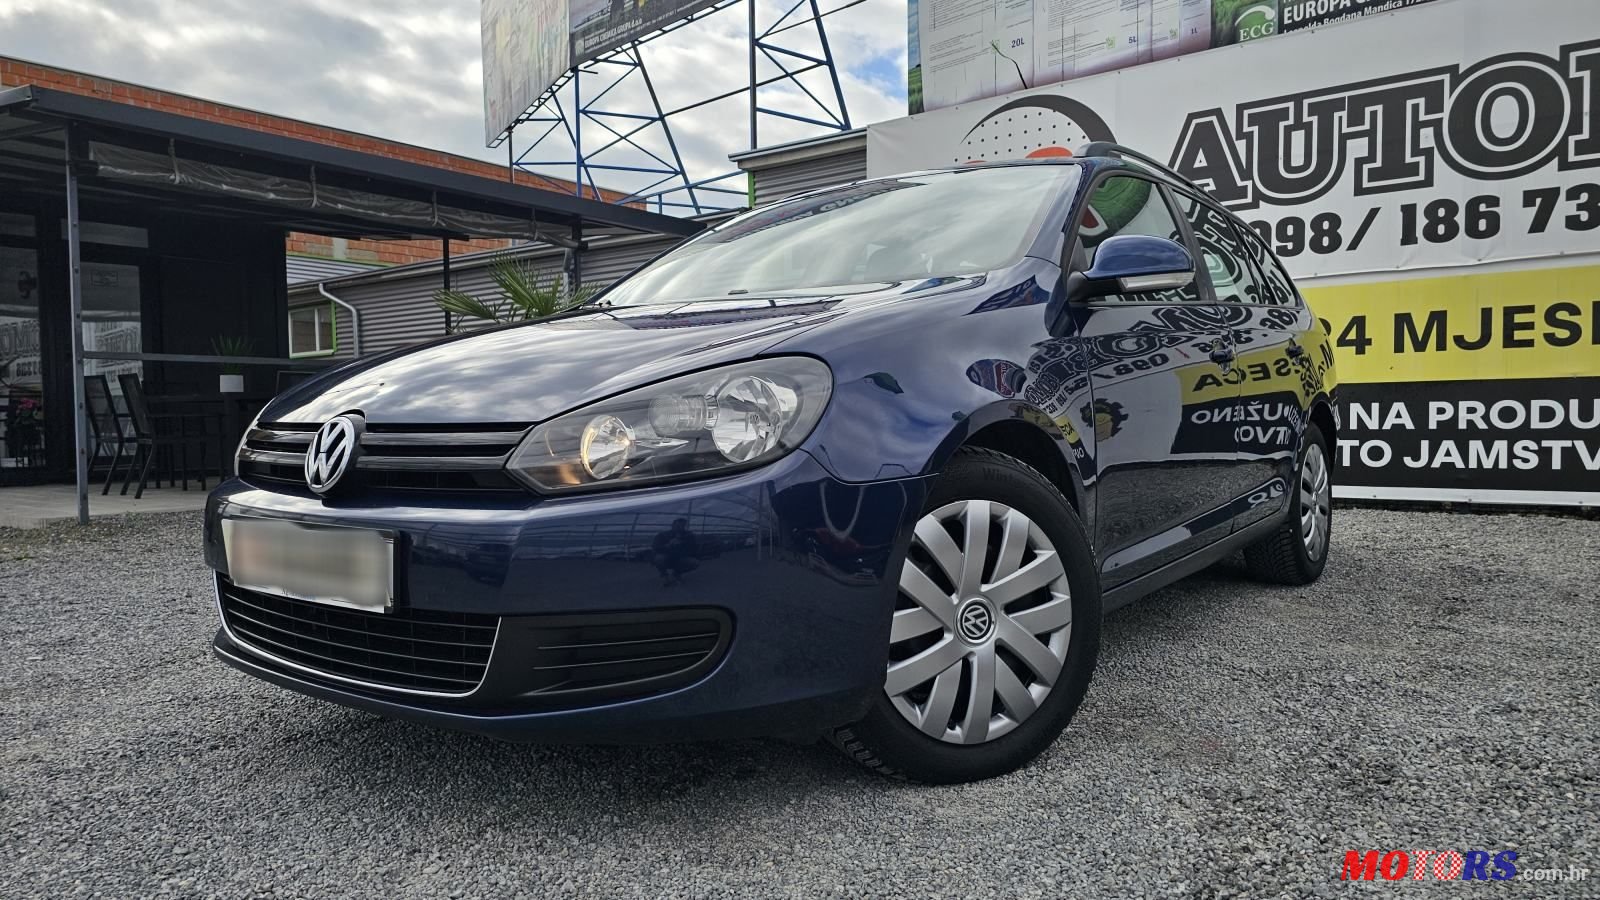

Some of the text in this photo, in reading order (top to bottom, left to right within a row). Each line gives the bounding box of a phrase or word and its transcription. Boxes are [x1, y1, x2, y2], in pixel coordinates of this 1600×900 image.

[1011, 37, 1025, 48] 20L
[1239, 22, 1274, 42] ECG
[1400, 194, 1501, 246] 186
[1394, 300, 1600, 354] MJES
[1349, 402, 1415, 430] NA
